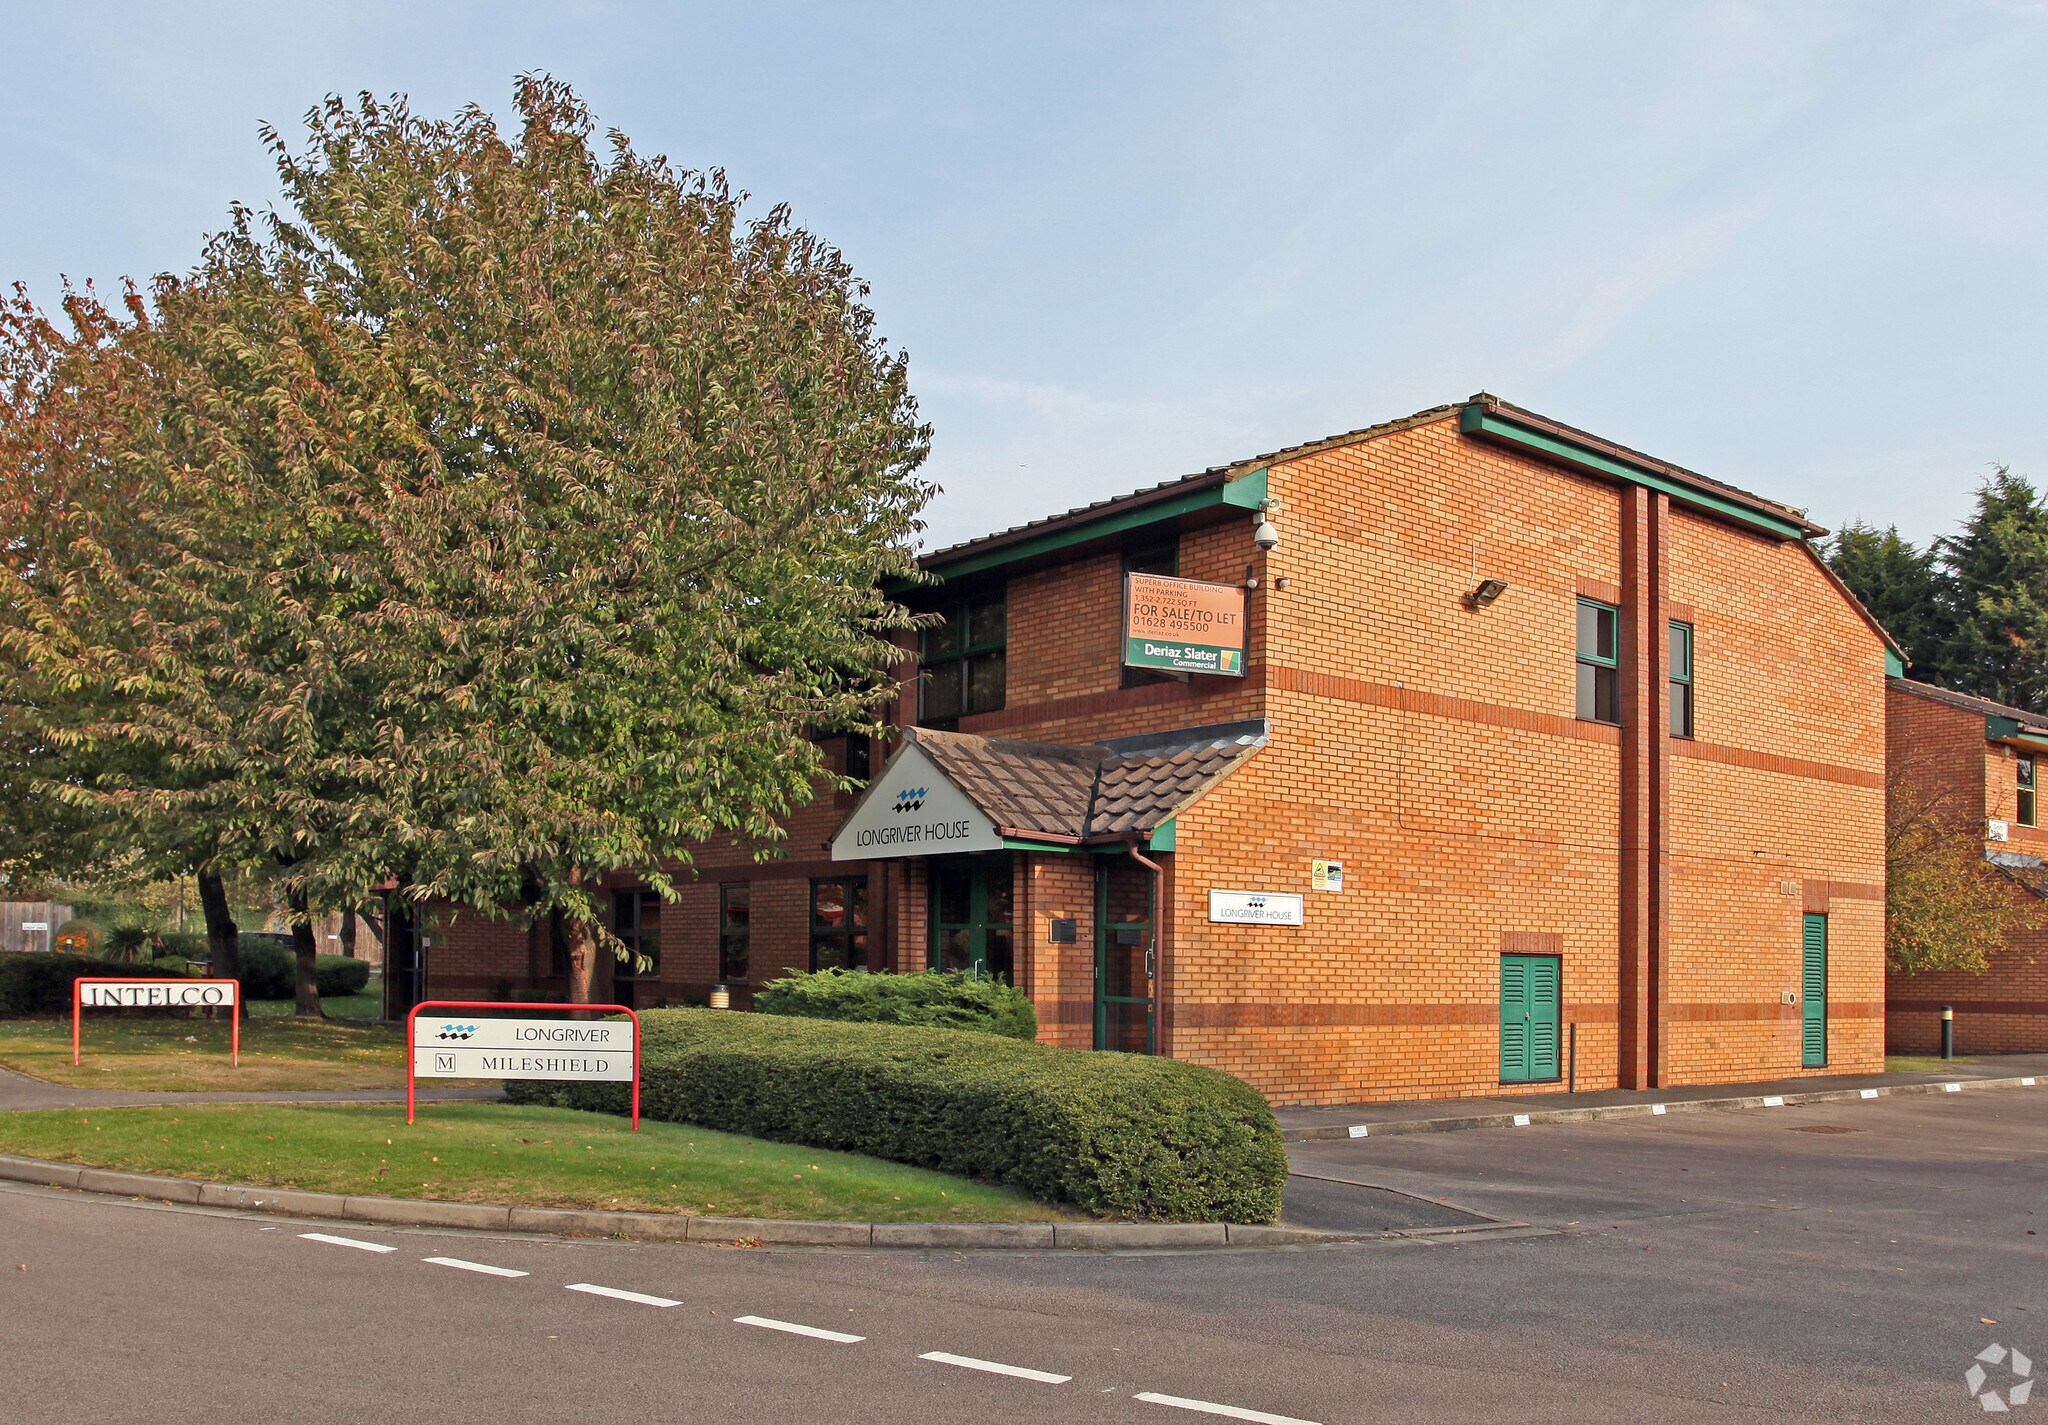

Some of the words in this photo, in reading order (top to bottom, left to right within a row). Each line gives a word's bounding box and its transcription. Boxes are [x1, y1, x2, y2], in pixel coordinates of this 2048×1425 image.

[1134, 586, 1155, 594] WITH
[1156, 588, 1188, 598] PARKING
[1135, 578, 1162, 587] SUPERB
[1163, 581, 1188, 590] OFFICE
[1189, 584, 1223, 593] BUILDING
[1134, 603, 1158, 617] FOR
[1162, 606, 1213, 623] SALE/TO
[1217, 612, 1236, 625] LET
[1133, 615, 1166, 628] 01628
[1169, 620, 1209, 633] 495500
[1145, 643, 1182, 659] Deriaz
[1184, 647, 1218, 662] Slater
[1173, 658, 1217, 670] Commercial
[857, 825, 921, 847] LONGRIVER
[925, 820, 970, 841] HOUSE
[1220, 908, 1265, 919] LONGRIVER
[1266, 910, 1292, 921] HOUSE
[91, 987, 223, 1006] INTELCO
[516, 1027, 610, 1043] LONGRIVER
[482, 1056, 609, 1073] MILESHIELD
